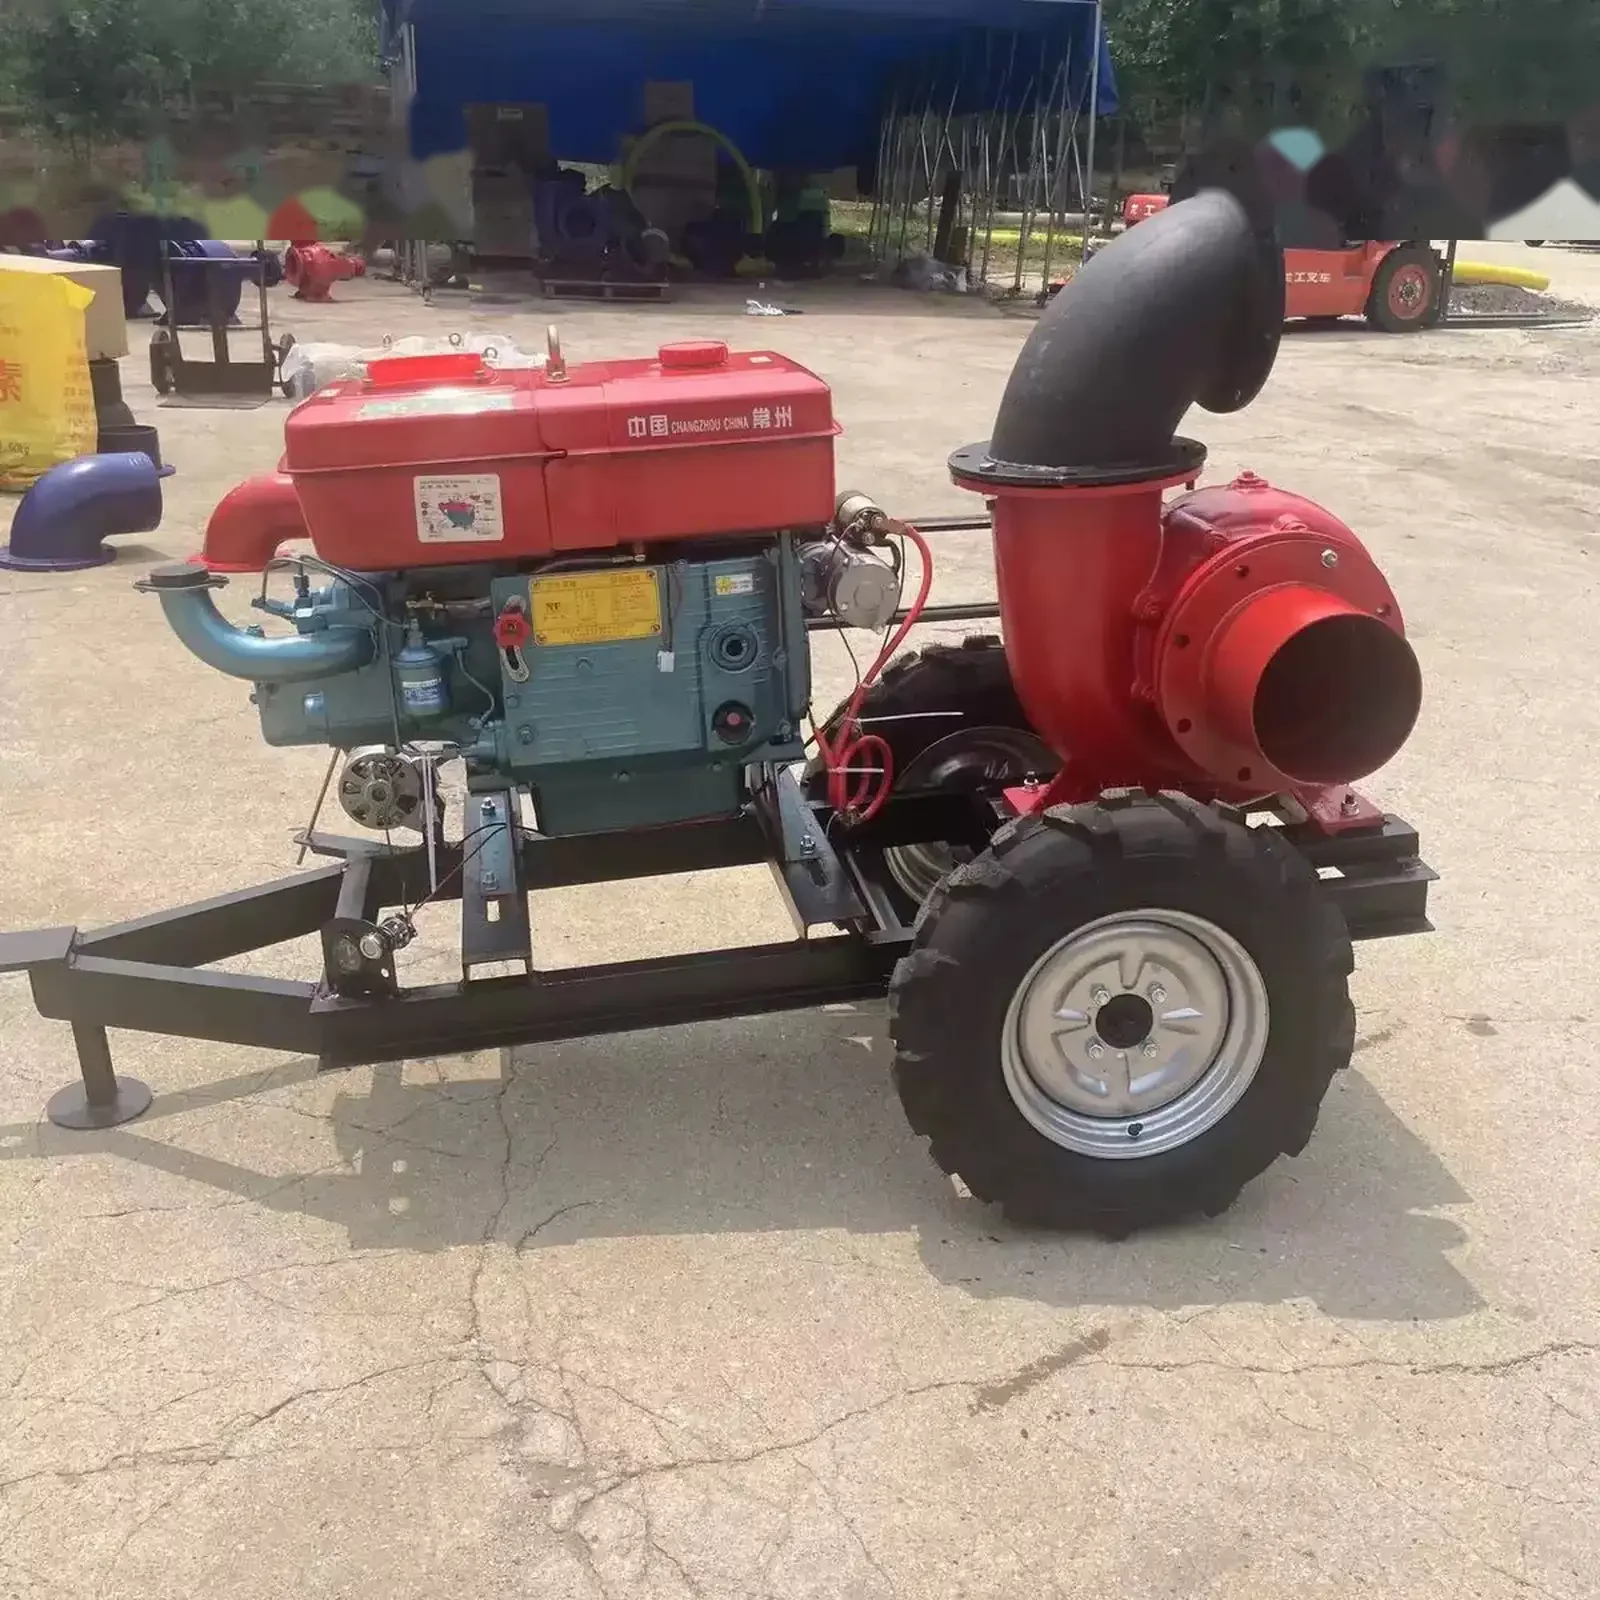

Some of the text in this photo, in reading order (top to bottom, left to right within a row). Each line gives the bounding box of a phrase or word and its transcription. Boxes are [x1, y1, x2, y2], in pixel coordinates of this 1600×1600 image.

[1130, 203, 1156, 216] 工
[628, 405, 793, 438] 中国 CHANGZHOU CHINA 常州
